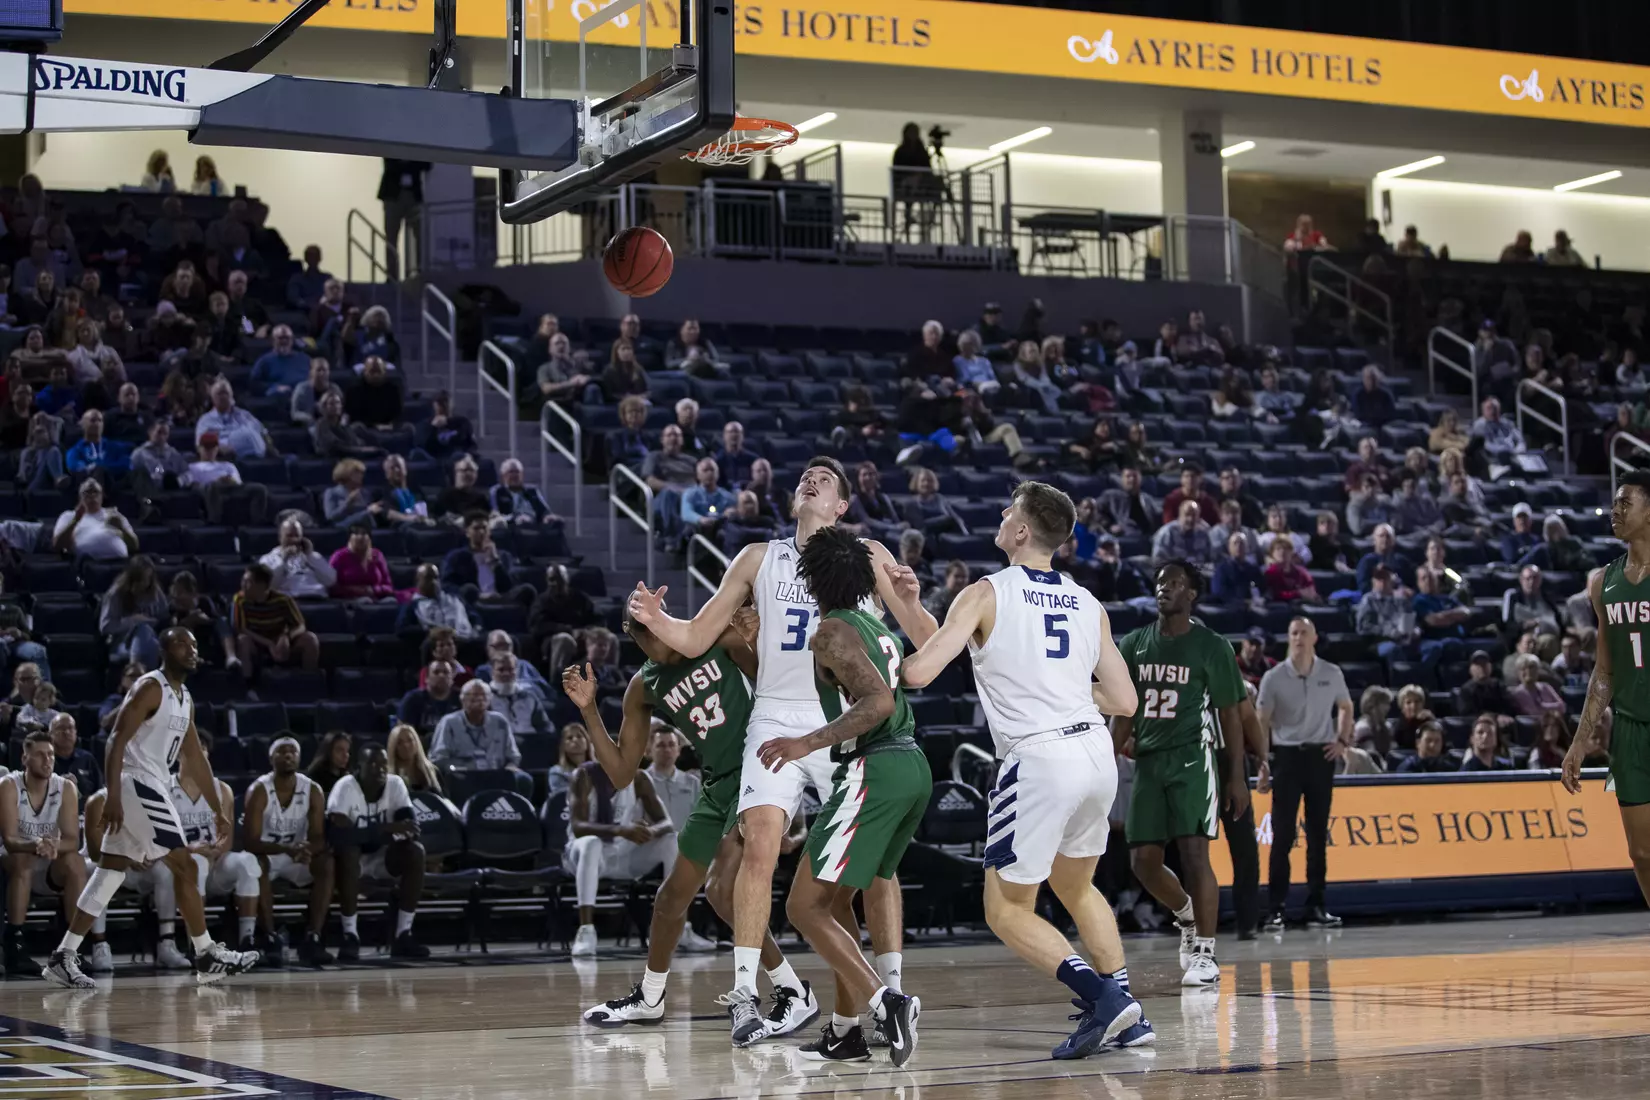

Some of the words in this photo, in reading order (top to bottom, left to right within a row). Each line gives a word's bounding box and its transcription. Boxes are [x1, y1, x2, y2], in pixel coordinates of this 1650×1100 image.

[636, 0, 763, 35] AYS
[781, 9, 931, 47] HOTELS
[1126, 37, 1236, 73] AYRES
[1251, 48, 1382, 86] HOTELS
[34, 58, 186, 103] SPALDING
[1550, 77, 1645, 110] AYRES
[776, 581, 820, 604] LAN
[1022, 589, 1080, 611] NOTTAGE
[781, 608, 820, 651] 3
[1605, 600, 1650, 625] MVS
[1044, 614, 1070, 659] 5
[1629, 632, 1644, 668] 1
[878, 634, 900, 690] 2
[1138, 663, 1190, 685] MVSU
[663, 659, 722, 713] MVSU
[1144, 688, 1178, 718] 22
[689, 692, 726, 740] 33
[167, 735, 180, 765] 0
[482, 812, 521, 820] adidas
[1432, 808, 1588, 843] HOTELS
